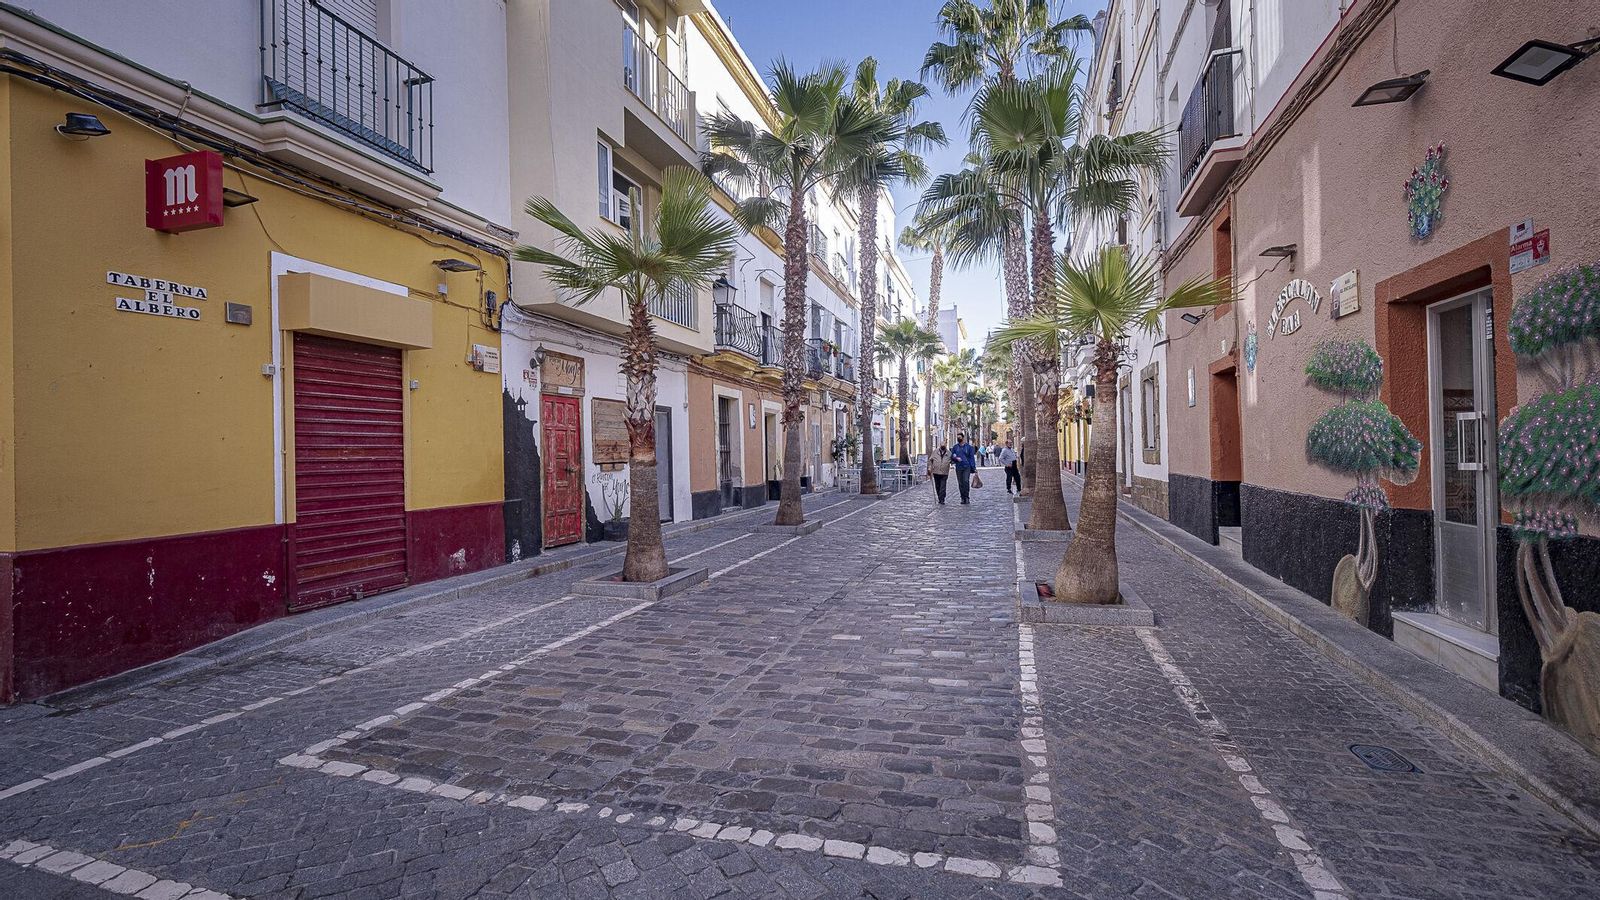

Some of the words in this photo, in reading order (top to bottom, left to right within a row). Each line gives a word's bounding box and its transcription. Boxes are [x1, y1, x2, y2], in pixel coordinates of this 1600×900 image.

[1510, 240, 1533, 253] Alarma
[108, 271, 208, 299] TABERNA
[148, 291, 173, 304] EL
[117, 301, 200, 319] ALBERO
[1280, 312, 1300, 334] BAR
